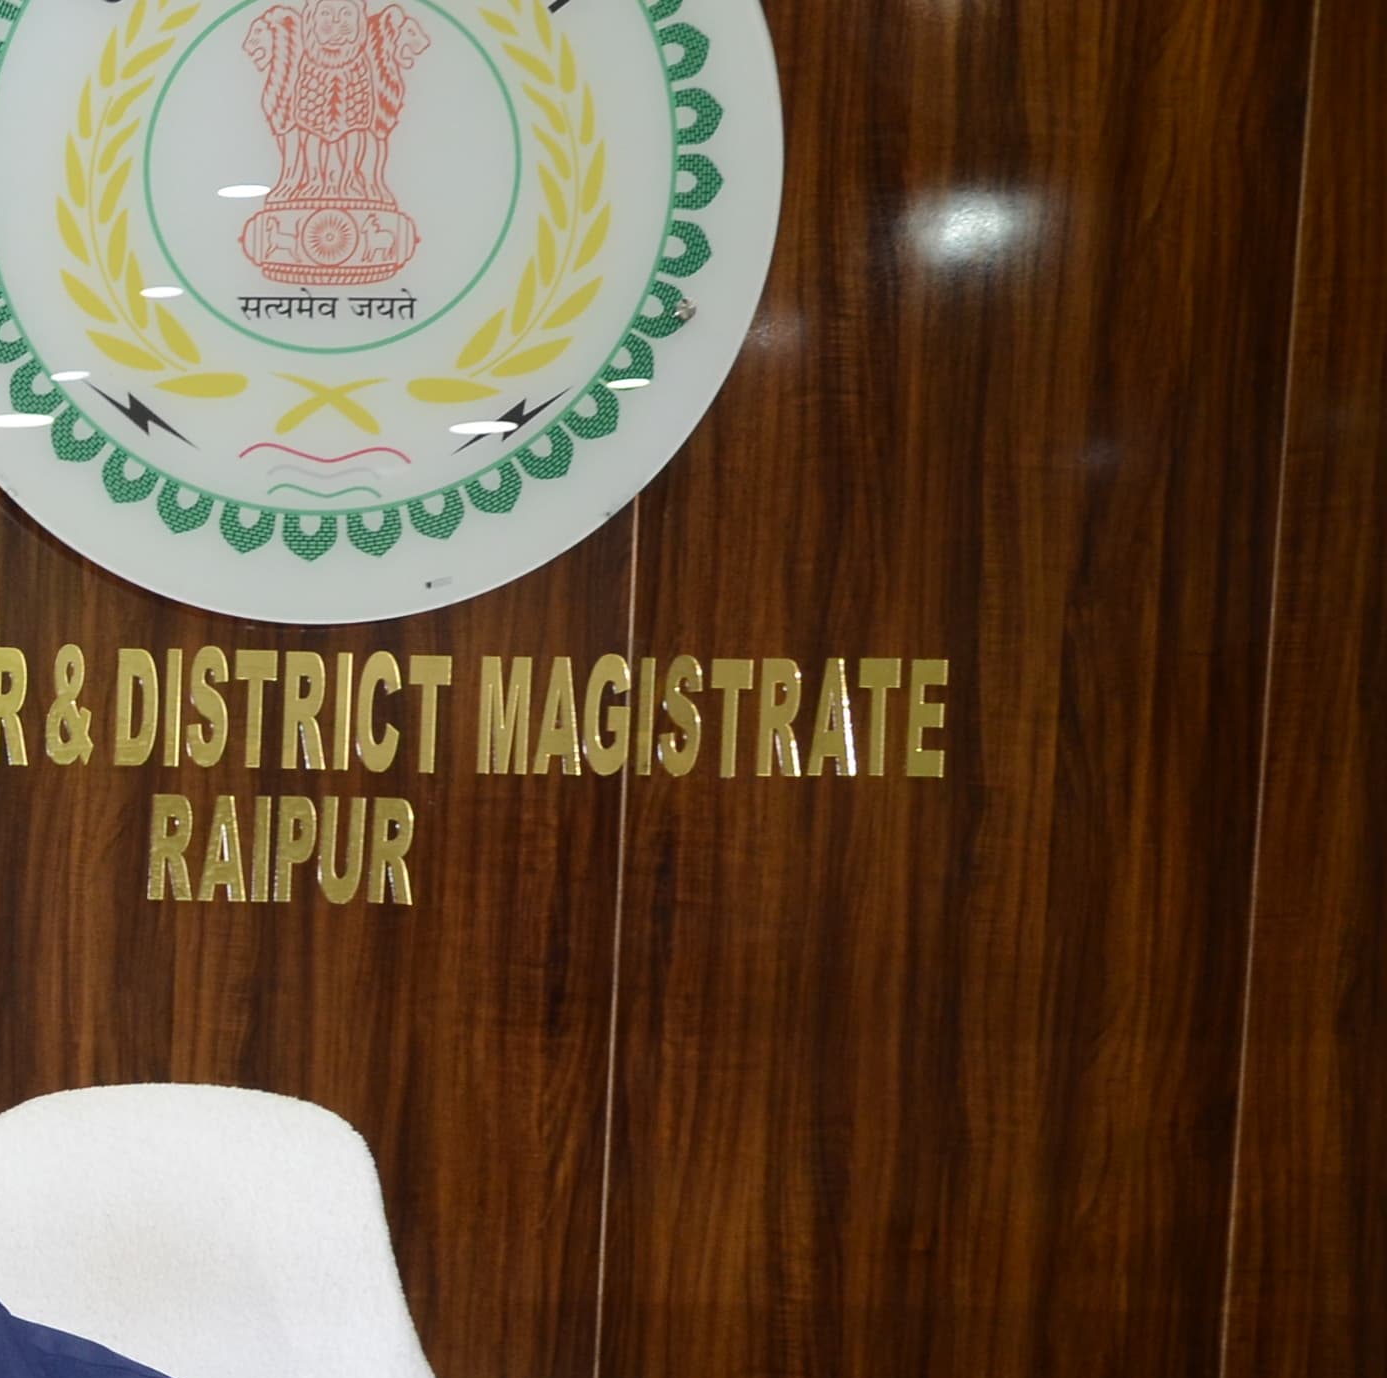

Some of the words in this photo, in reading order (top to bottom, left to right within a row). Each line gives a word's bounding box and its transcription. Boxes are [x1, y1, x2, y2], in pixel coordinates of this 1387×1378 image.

[237, 287, 339, 320] सत्यमेव
[347, 288, 418, 320] जयते
[45, 643, 94, 766] &
[113, 645, 453, 773] DISTRICT
[475, 653, 949, 779] MAGISTRATE
[146, 793, 416, 905] RAIPUR
